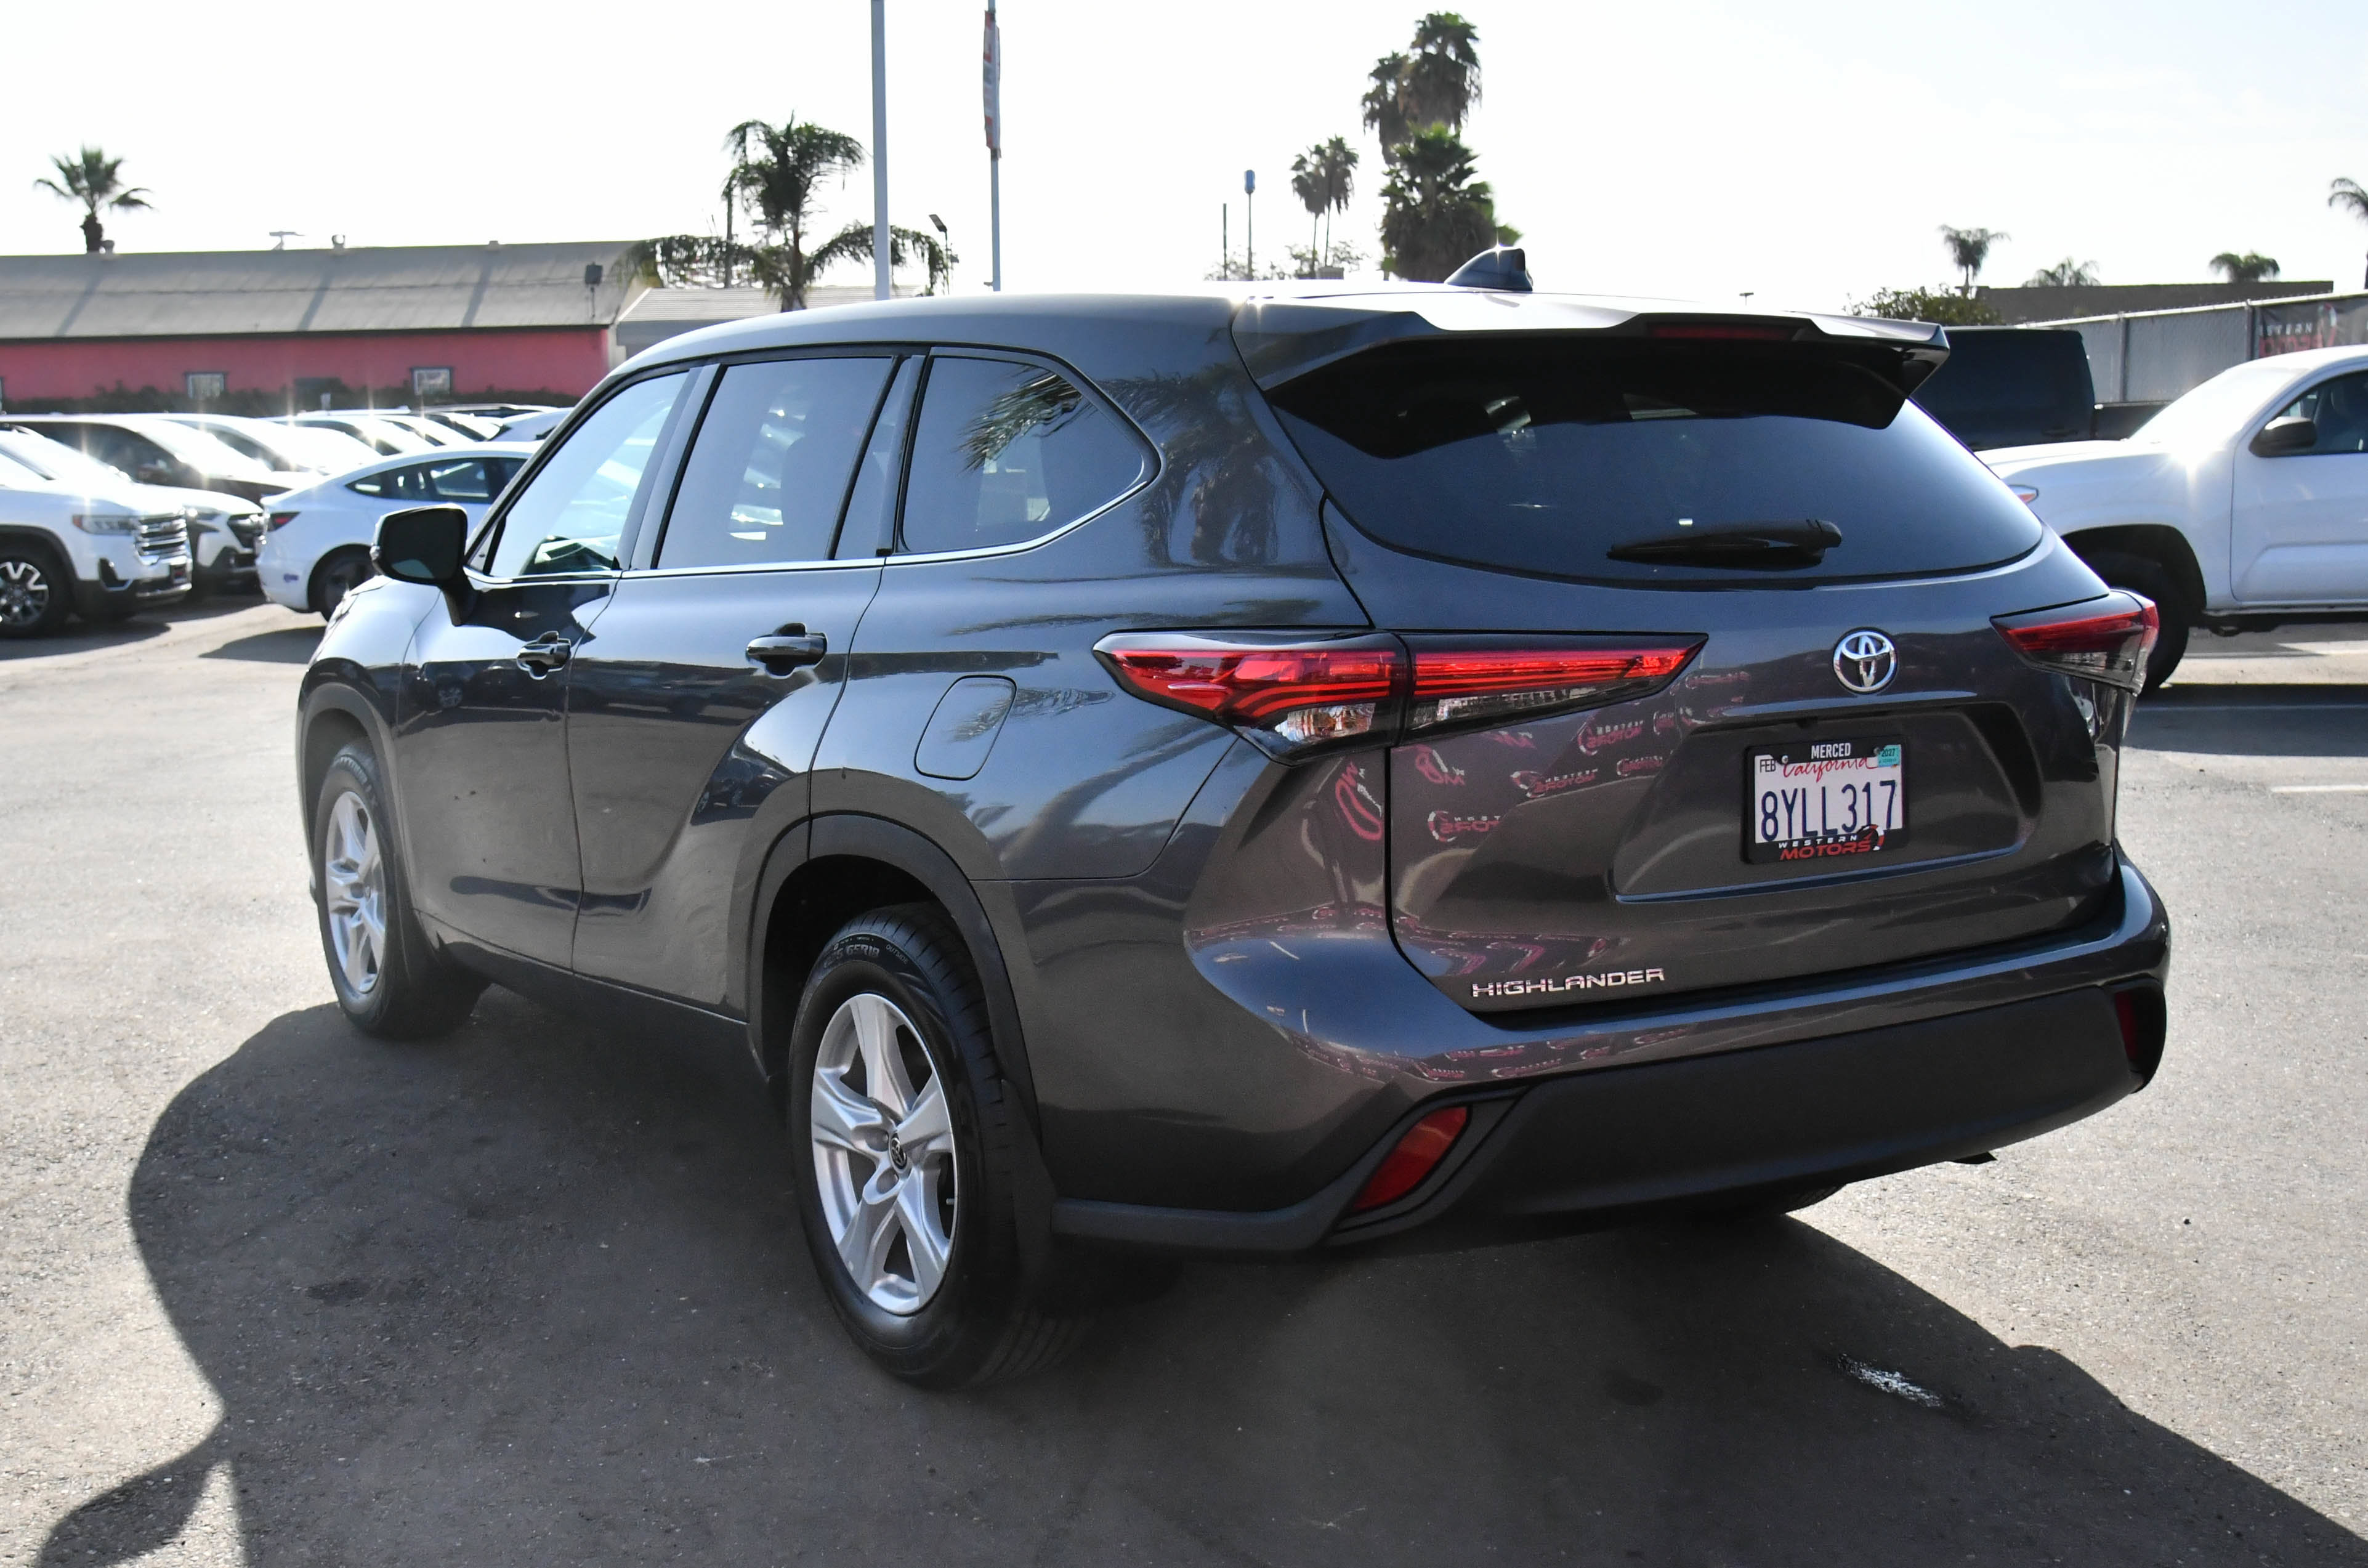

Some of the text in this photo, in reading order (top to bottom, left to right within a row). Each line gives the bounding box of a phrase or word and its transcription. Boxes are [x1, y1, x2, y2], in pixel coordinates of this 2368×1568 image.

[1811, 743, 1851, 759] MERCED
[1881, 748, 1896, 758] 2027
[1760, 759, 1776, 773] FEB
[1783, 758, 1878, 783] California
[1761, 779, 1896, 842] 8YLL317
[1779, 835, 1857, 849] WESTERN
[1780, 841, 1871, 860] MOTORS
[1473, 968, 1665, 997] HIGHLANDER
